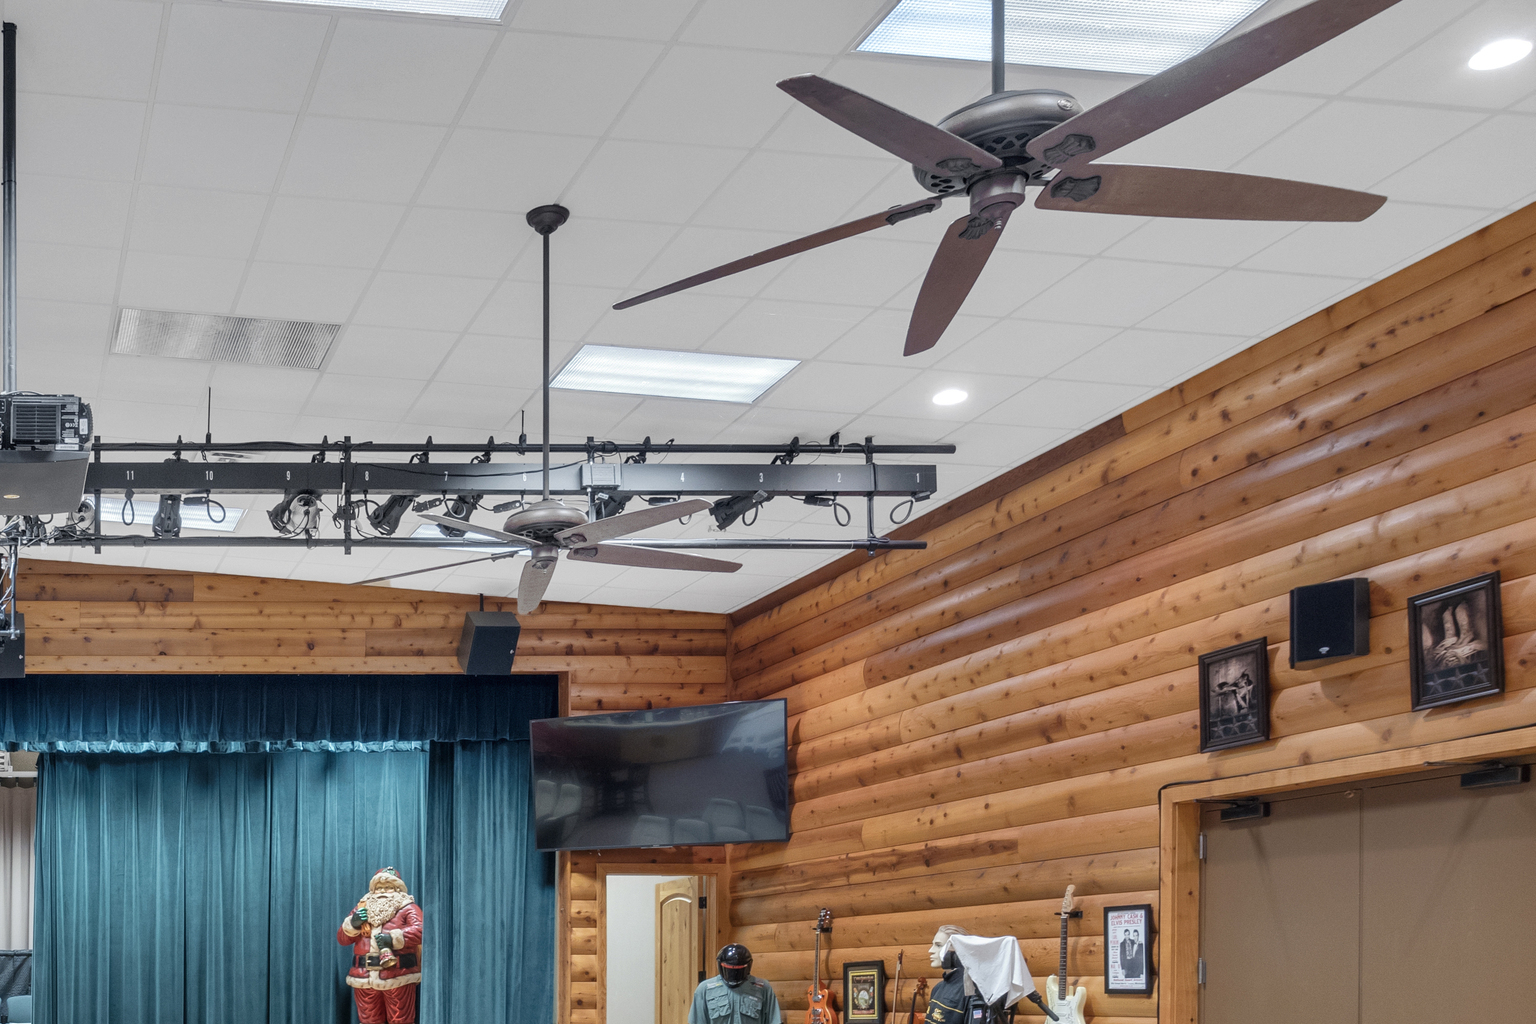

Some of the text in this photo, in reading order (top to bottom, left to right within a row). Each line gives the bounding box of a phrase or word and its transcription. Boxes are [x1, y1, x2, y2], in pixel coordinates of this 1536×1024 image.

[126, 471, 134, 481] 11
[205, 471, 214, 481] 10
[286, 471, 291, 481] 9
[364, 471, 370, 481] 8
[680, 473, 685, 483] 4
[759, 473, 764, 483] 3
[837, 473, 842, 483] 2
[916, 473, 920, 483] 1
